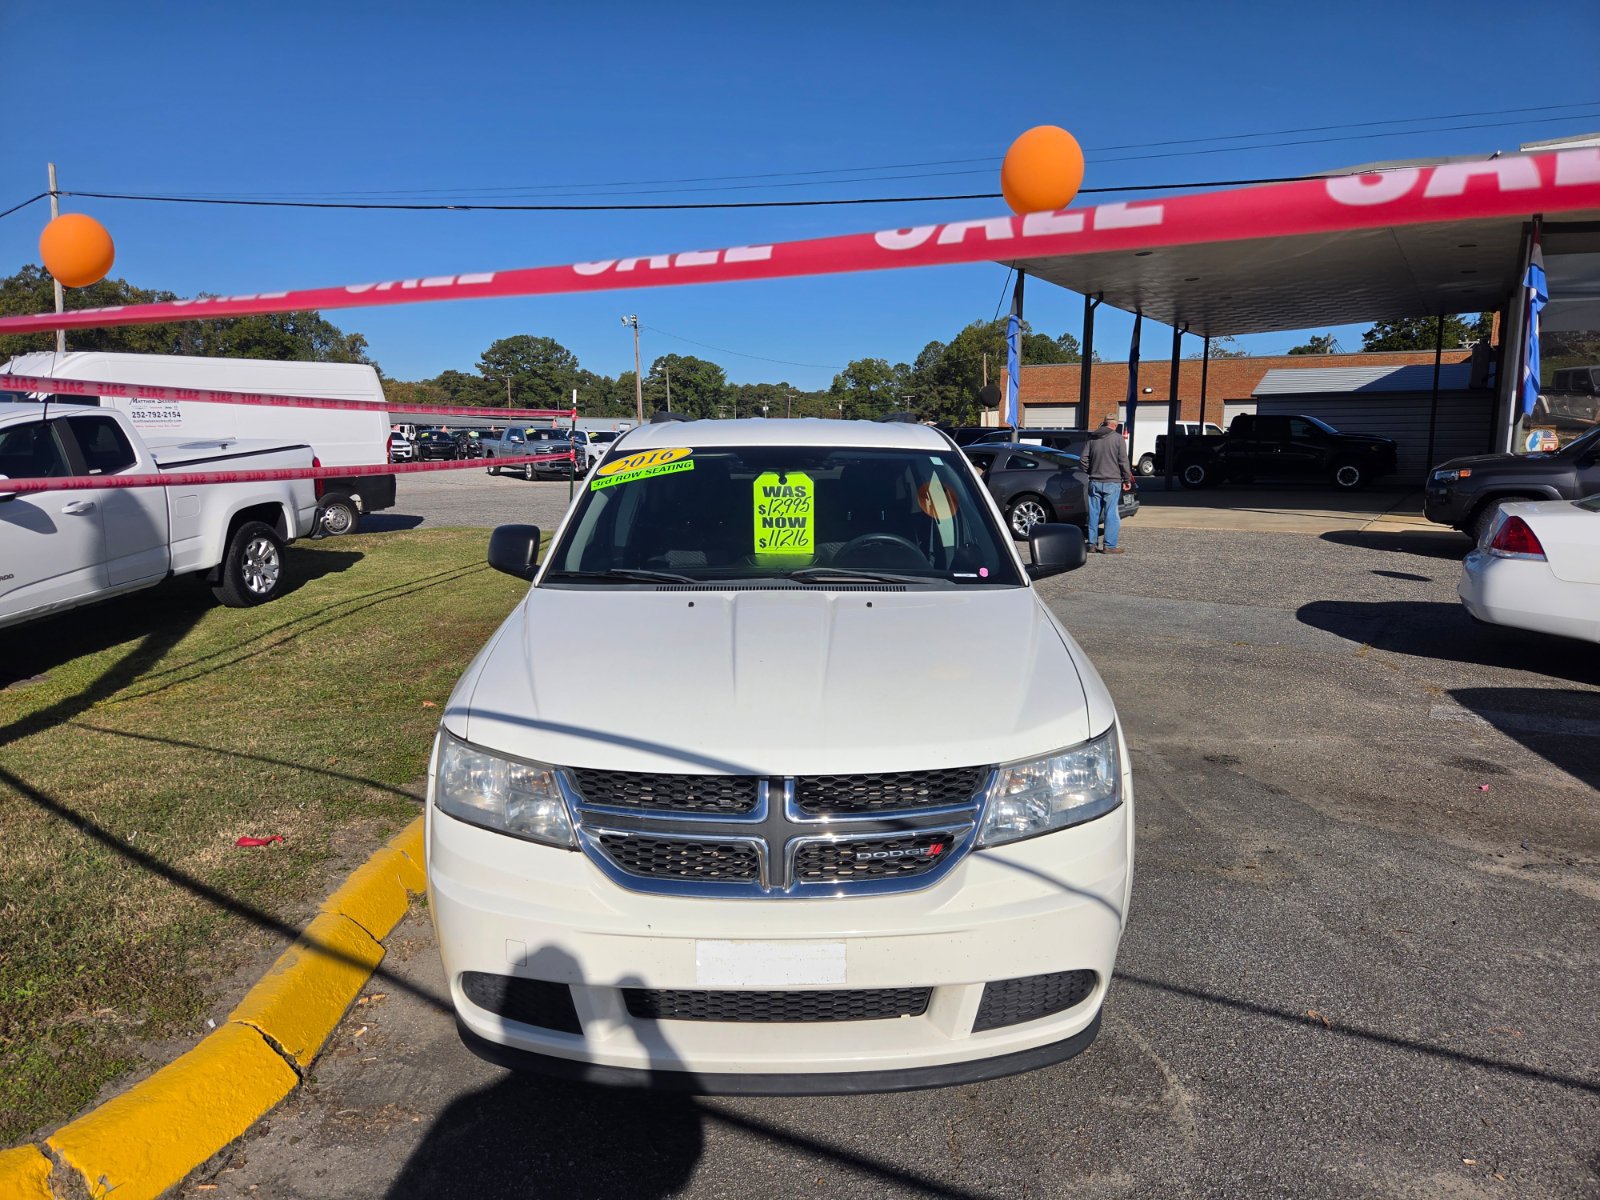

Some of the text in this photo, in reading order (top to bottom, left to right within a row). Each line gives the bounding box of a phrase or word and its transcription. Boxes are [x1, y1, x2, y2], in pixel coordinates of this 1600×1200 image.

[614, 450, 674, 473] 2016
[593, 461, 692, 487] 3rd ROW SEATING
[762, 486, 807, 498] WAS
[762, 517, 807, 529] NOW
[856, 847, 930, 859] DODGE
